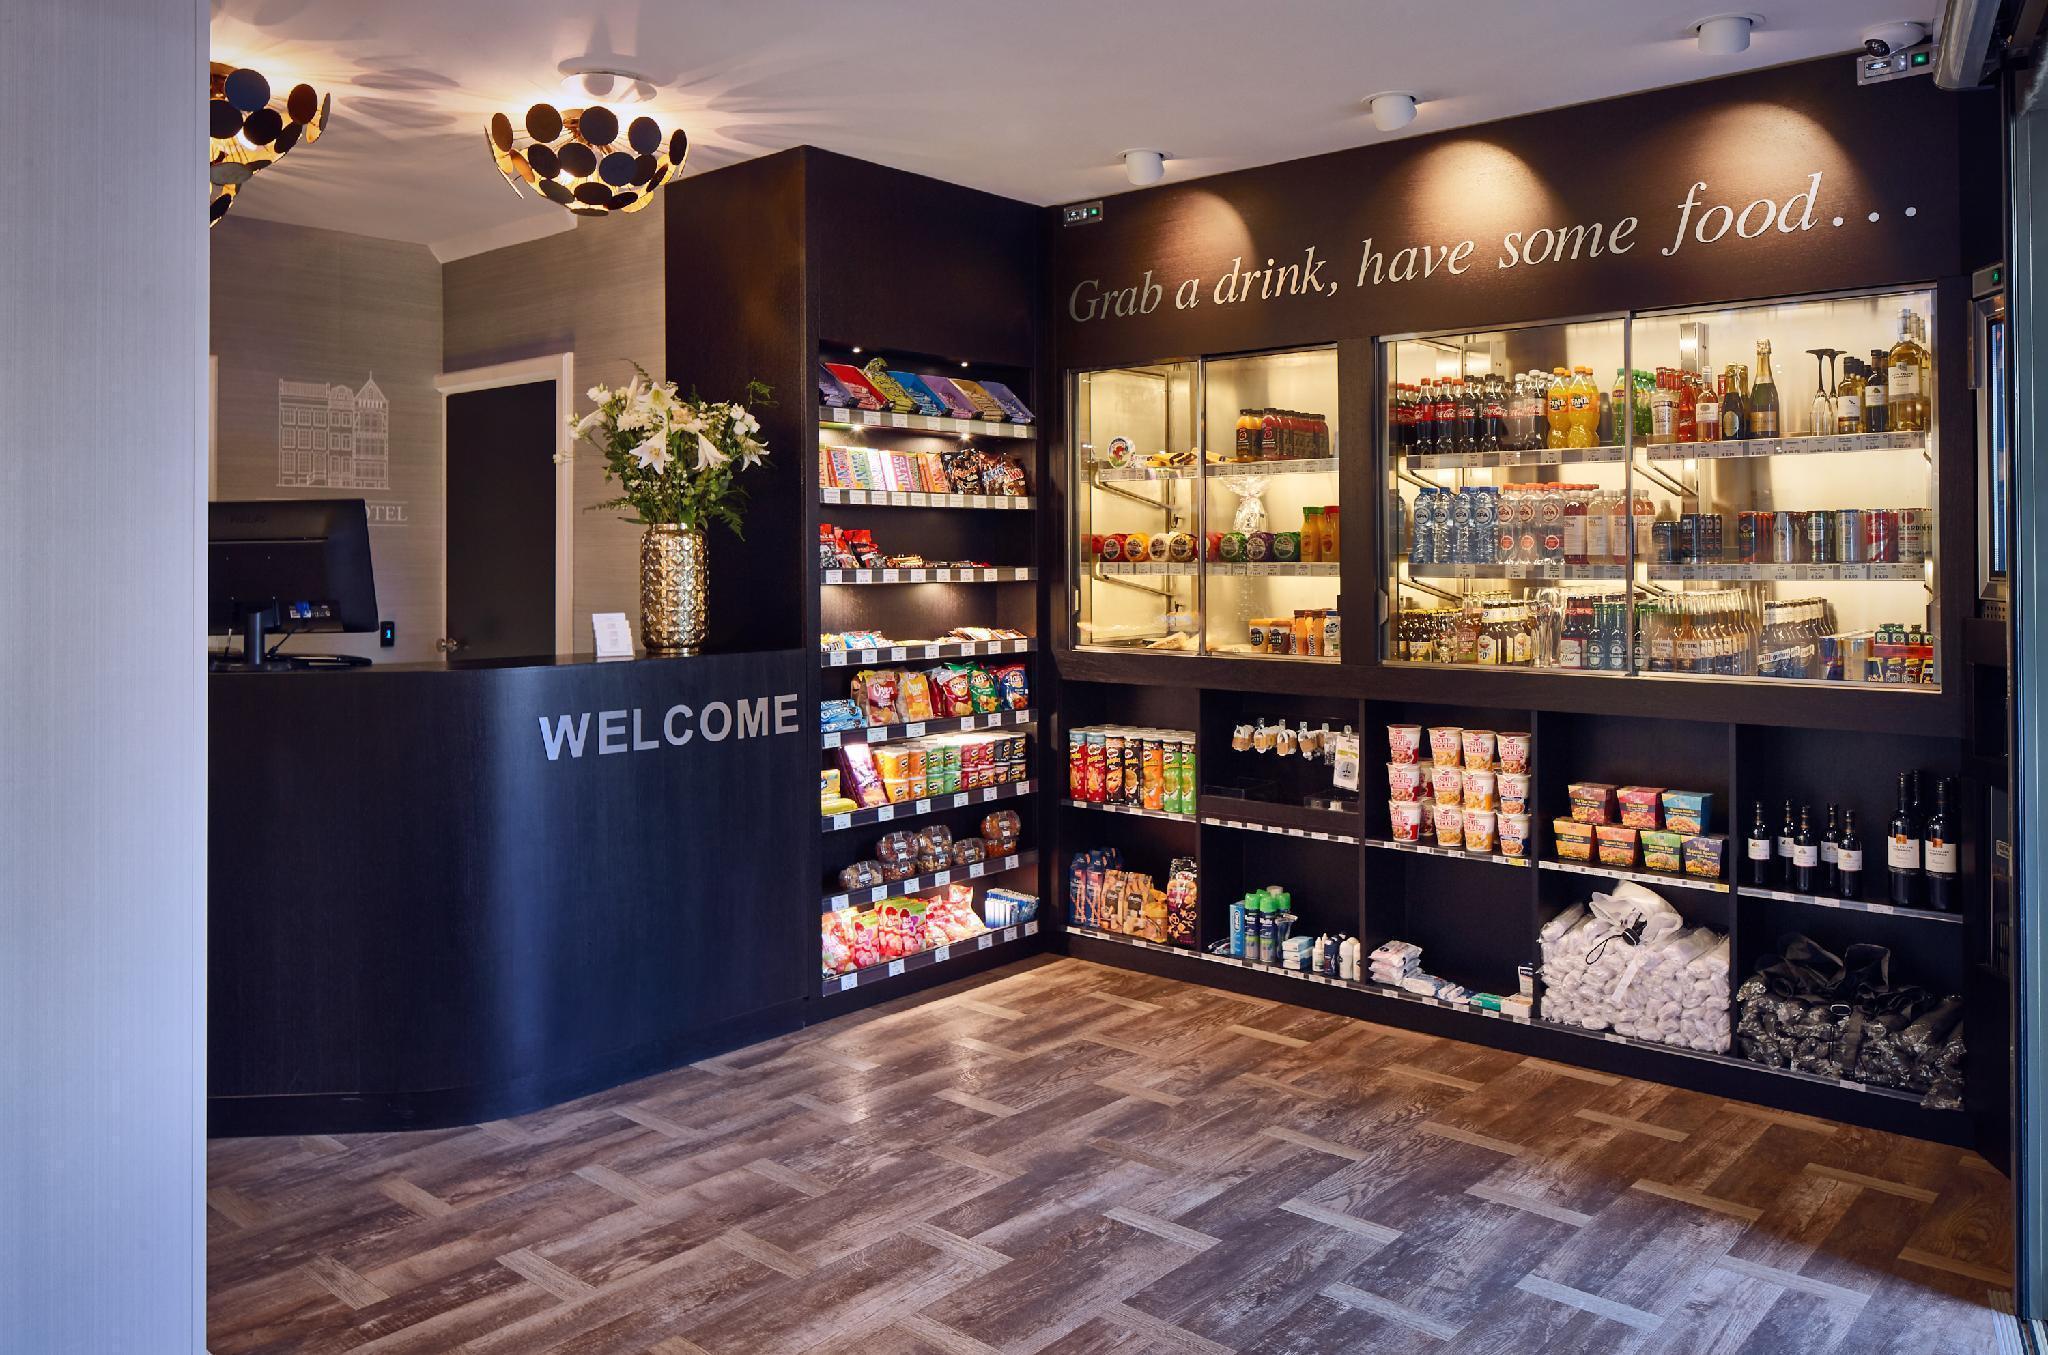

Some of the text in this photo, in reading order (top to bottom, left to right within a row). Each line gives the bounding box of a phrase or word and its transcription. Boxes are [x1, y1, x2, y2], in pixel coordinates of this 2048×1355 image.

[1069, 270, 1164, 322] Grab
[1175, 278, 1201, 310] a
[1213, 246, 1339, 305] drink,
[1356, 238, 1475, 287] have
[1498, 216, 1639, 270] some
[538, 693, 799, 761] WELCOME
